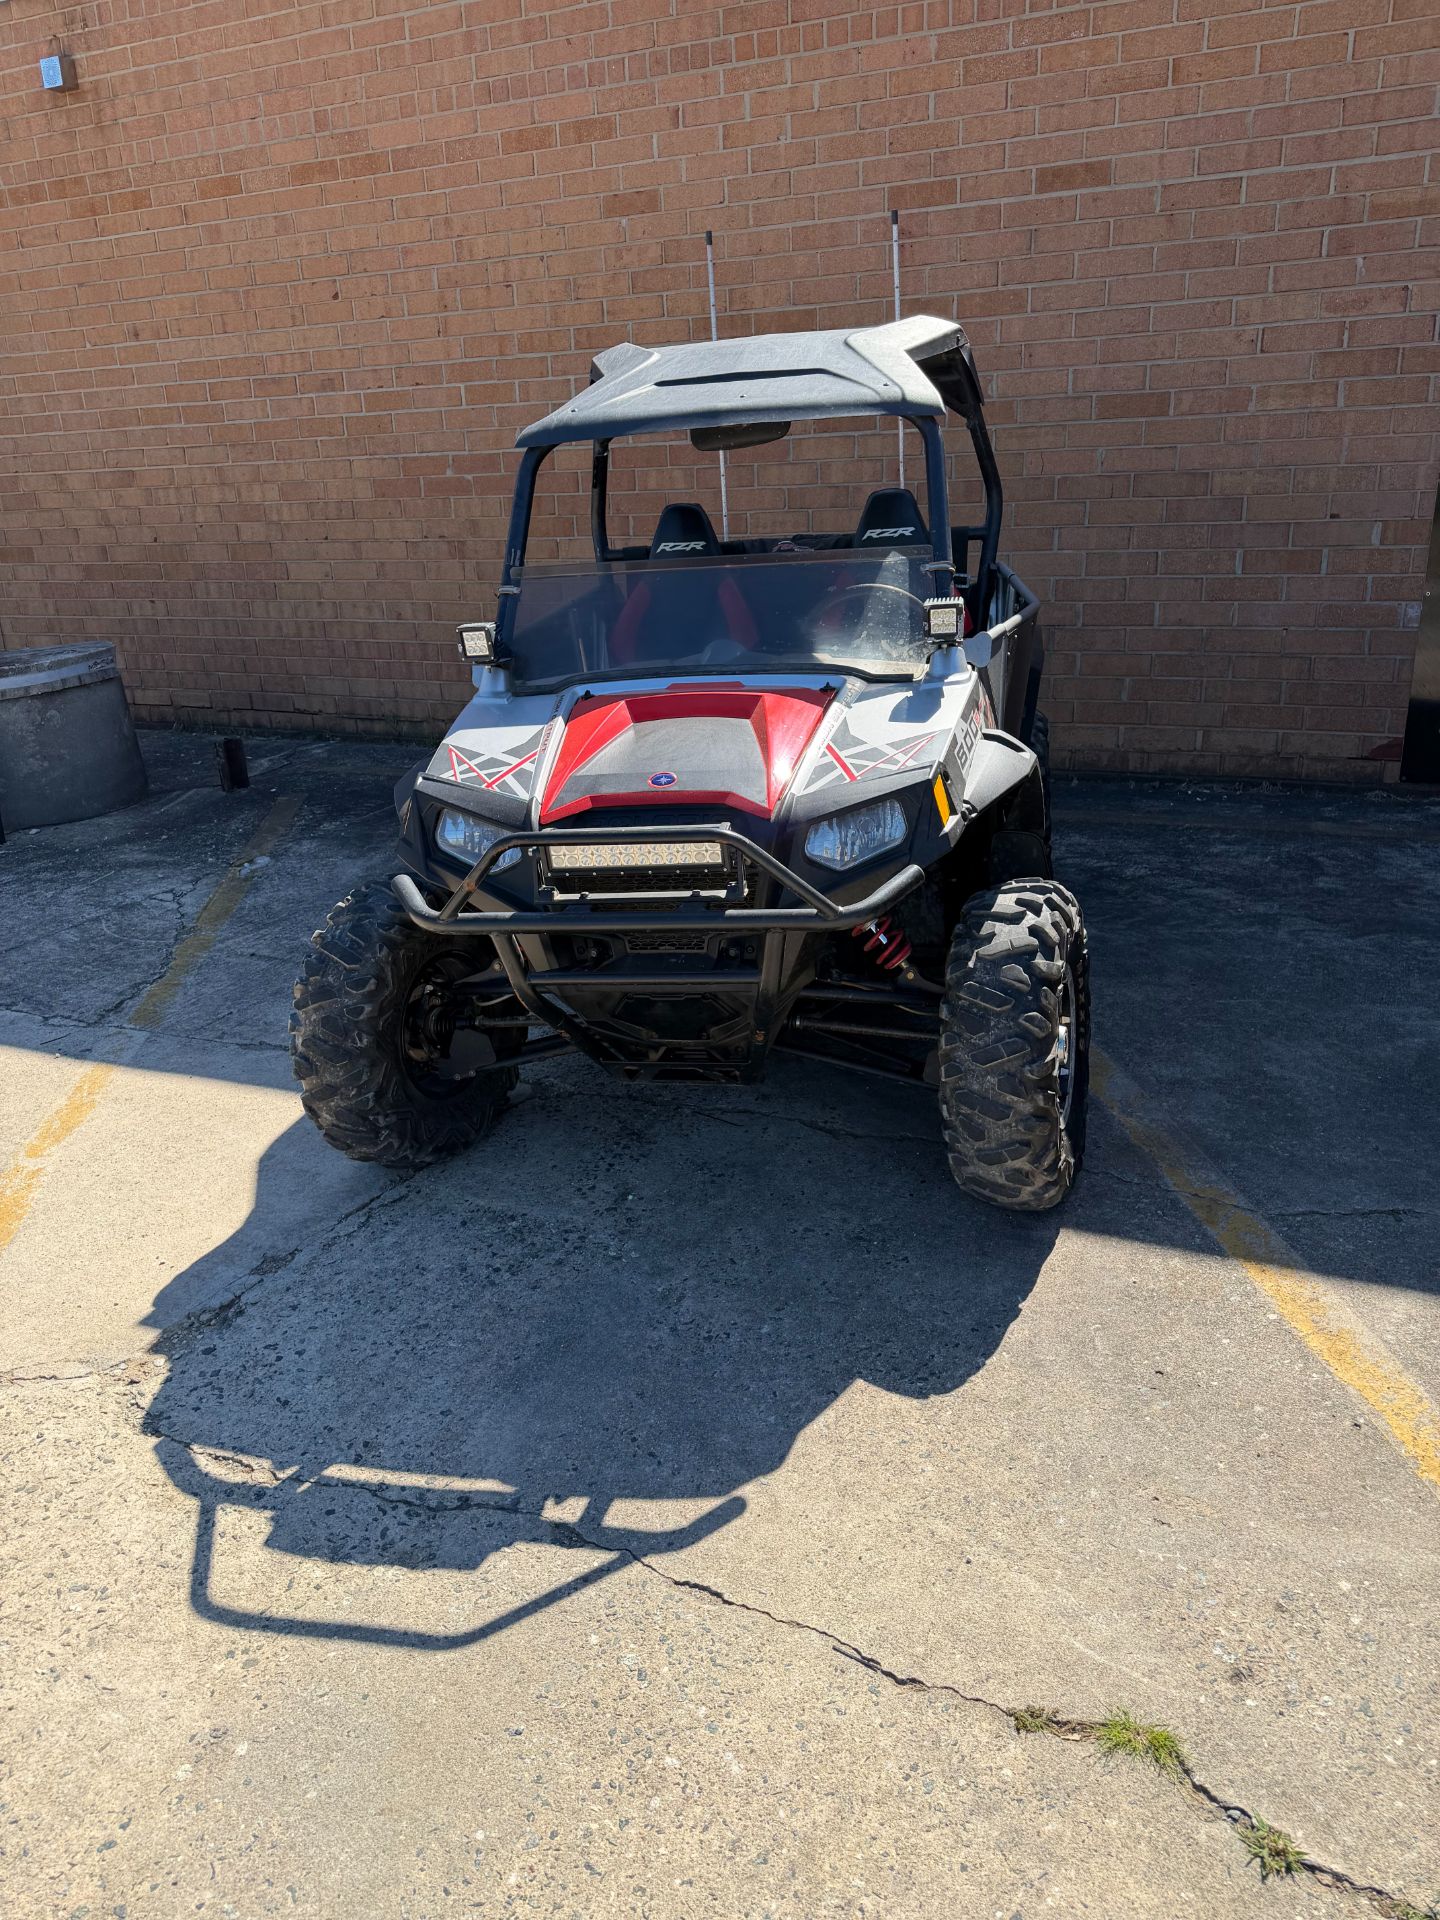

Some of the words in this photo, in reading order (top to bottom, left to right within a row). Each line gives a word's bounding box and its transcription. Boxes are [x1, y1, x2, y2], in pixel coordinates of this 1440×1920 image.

[861, 527, 916, 540] RZR
[656, 541, 707, 553] RZR
[955, 715, 979, 771] 800
